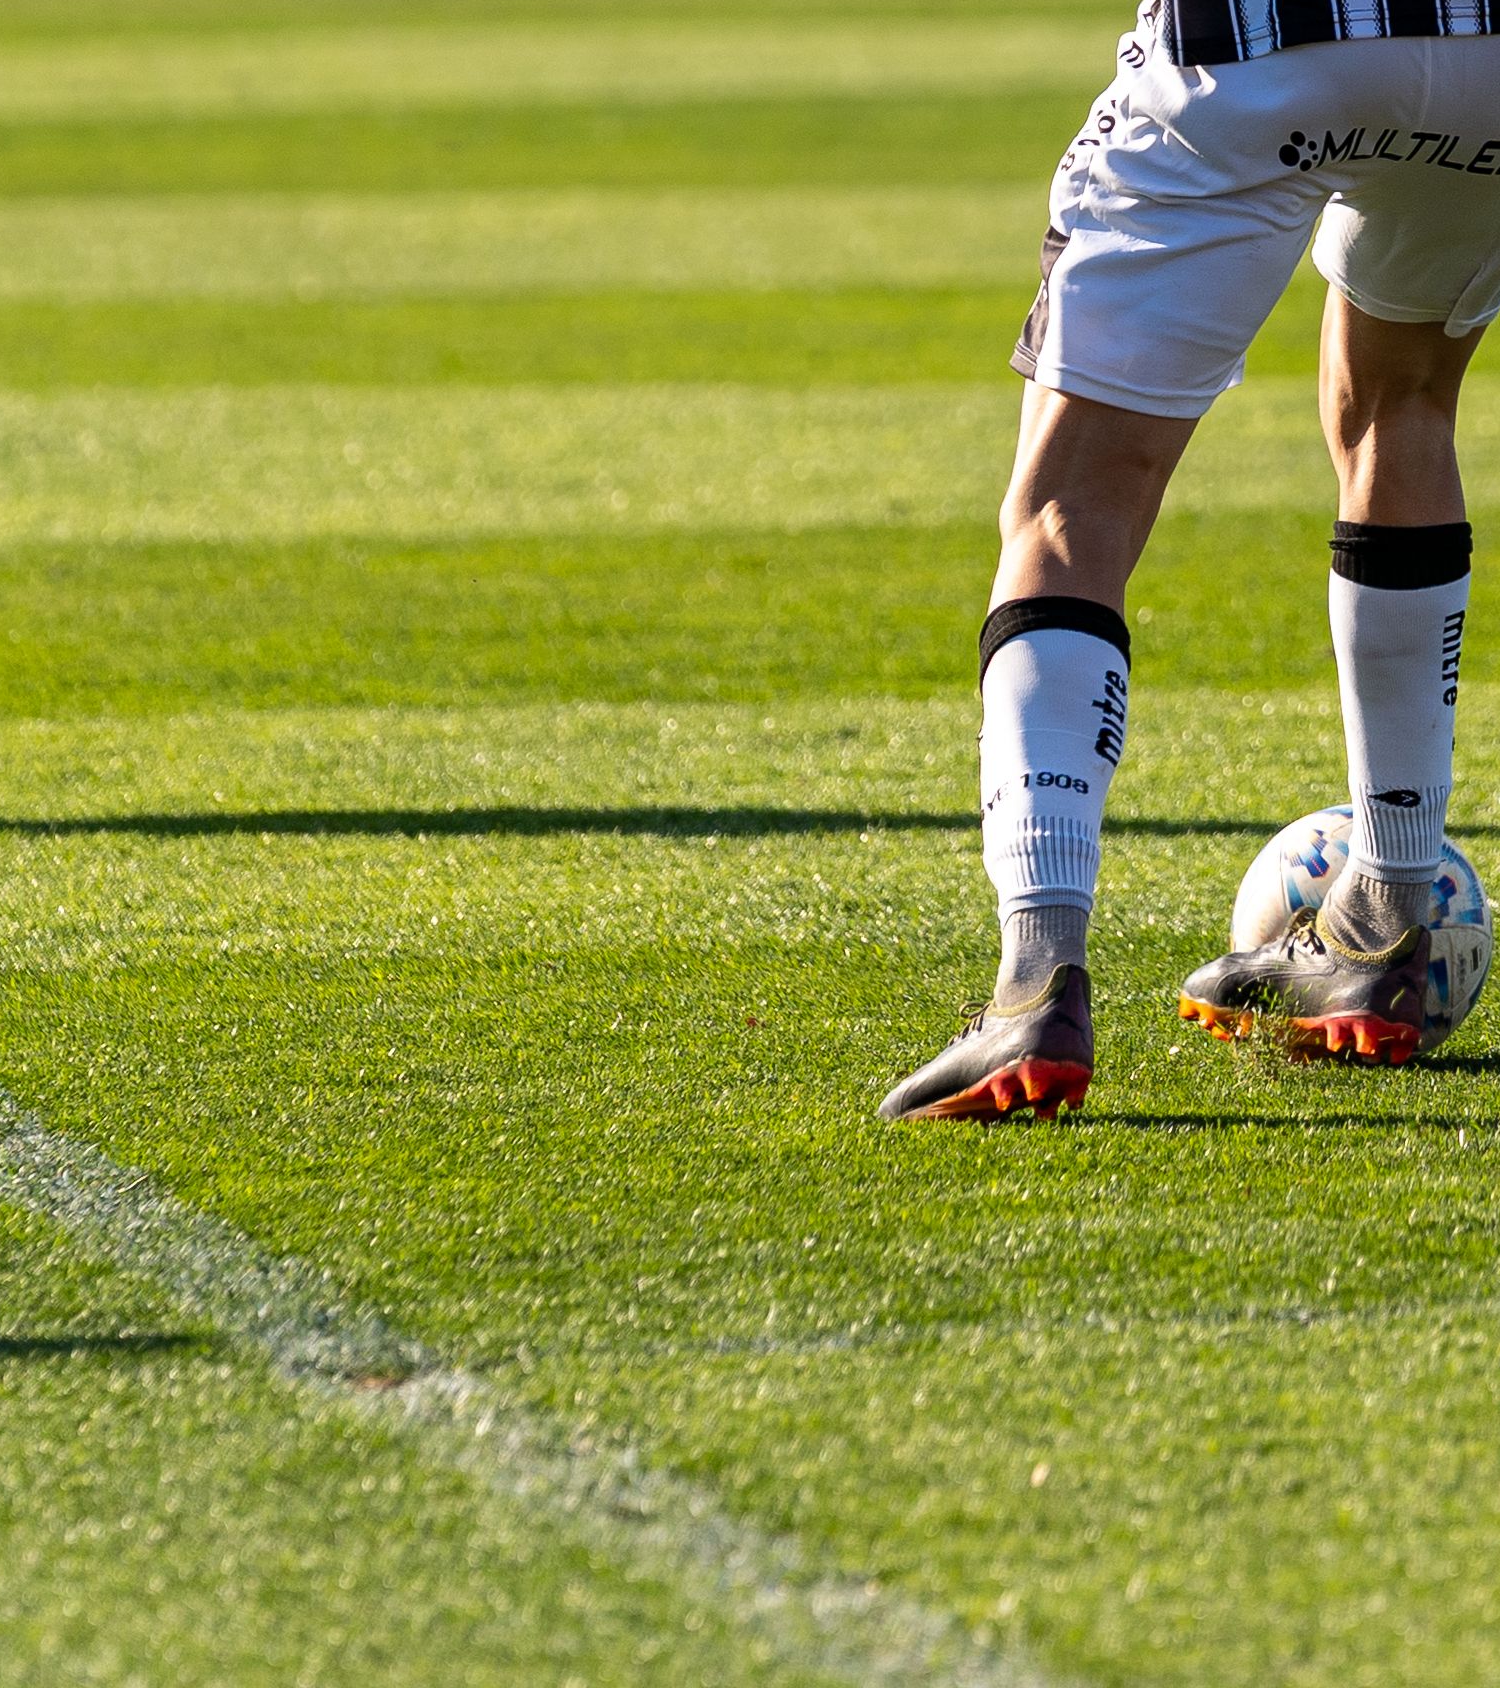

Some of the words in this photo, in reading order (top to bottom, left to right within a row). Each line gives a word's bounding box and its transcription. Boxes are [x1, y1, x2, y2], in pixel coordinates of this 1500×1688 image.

[1442, 610, 1466, 707] mitre
[1091, 669, 1128, 768] mitre
[1019, 770, 1090, 795] 1908
